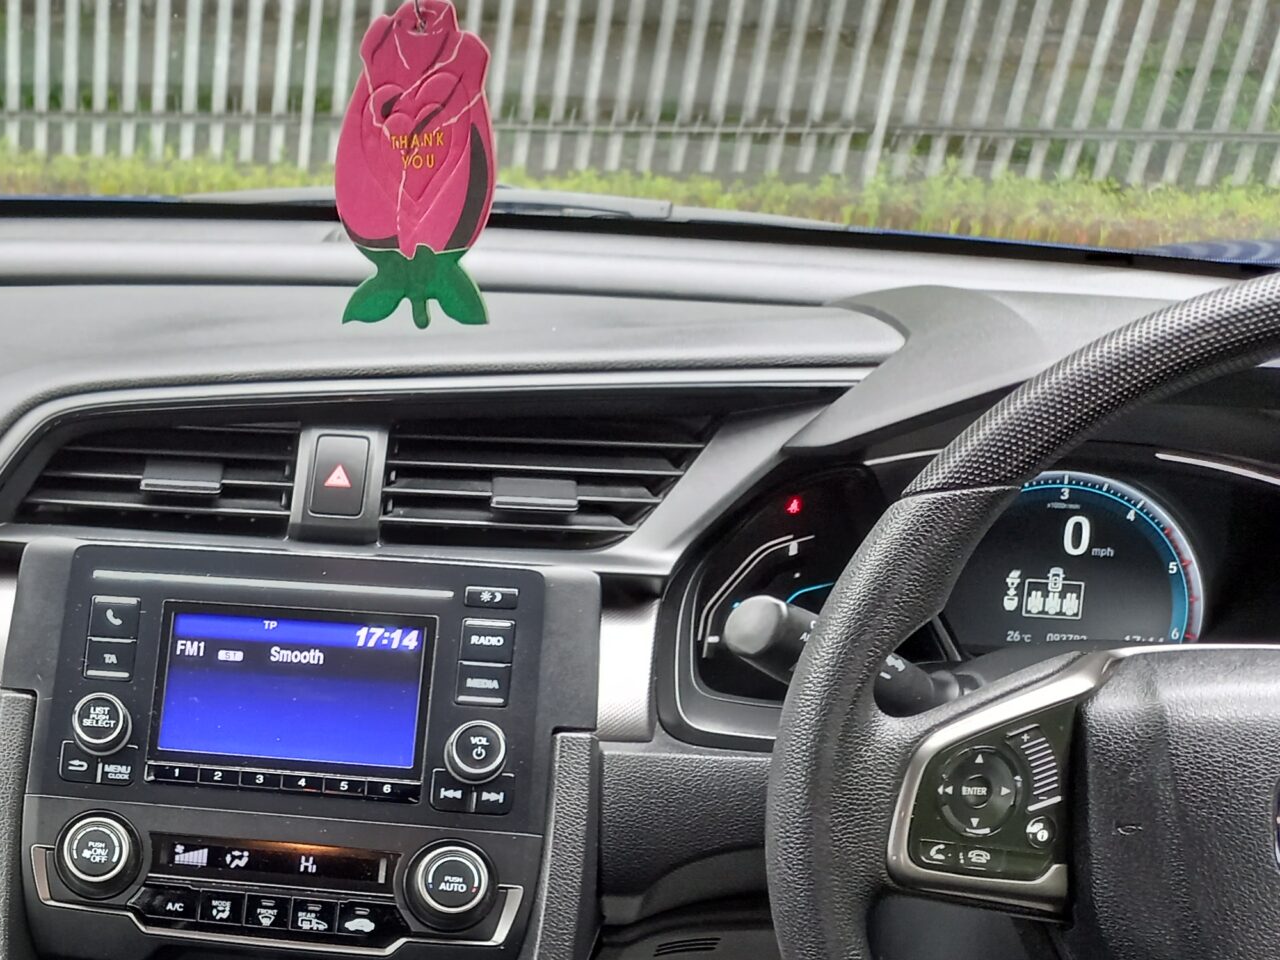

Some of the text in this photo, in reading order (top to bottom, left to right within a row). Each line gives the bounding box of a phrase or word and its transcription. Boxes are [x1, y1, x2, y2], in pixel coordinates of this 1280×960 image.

[391, 132, 445, 150] THANK
[402, 155, 436, 169] YOU
[1060, 488, 1070, 500] 3
[1126, 510, 1136, 522] 4
[1063, 515, 1114, 558] 0 mph
[1168, 562, 1178, 574] 5
[263, 620, 419, 650] TP 17:14
[1171, 627, 1180, 640] 6
[470, 635, 504, 646] RADIO
[176, 640, 205, 656] FM1
[270, 646, 324, 665] Smooth
[104, 654, 117, 664] TA
[466, 678, 499, 689] MEDIA
[90, 706, 110, 715] LIST
[83, 719, 116, 728] SELECT
[470, 736, 490, 745] VOL
[104, 764, 131, 774] MENU
[174, 768, 180, 777] 1
[213, 771, 222, 781] 2
[255, 774, 264, 784] 3
[298, 777, 306, 787] 4
[340, 781, 349, 791] 5
[383, 784, 392, 793] 6
[961, 785, 987, 796] ENTER
[88, 841, 106, 849] PUSH
[90, 855, 108, 863] OFF
[444, 875, 463, 883] PUSH
[439, 882, 467, 893] AUTO
[166, 902, 184, 912] A/C
[211, 900, 232, 909] MODE
[256, 908, 278, 916] FRONT
[298, 911, 316, 919] REAR
